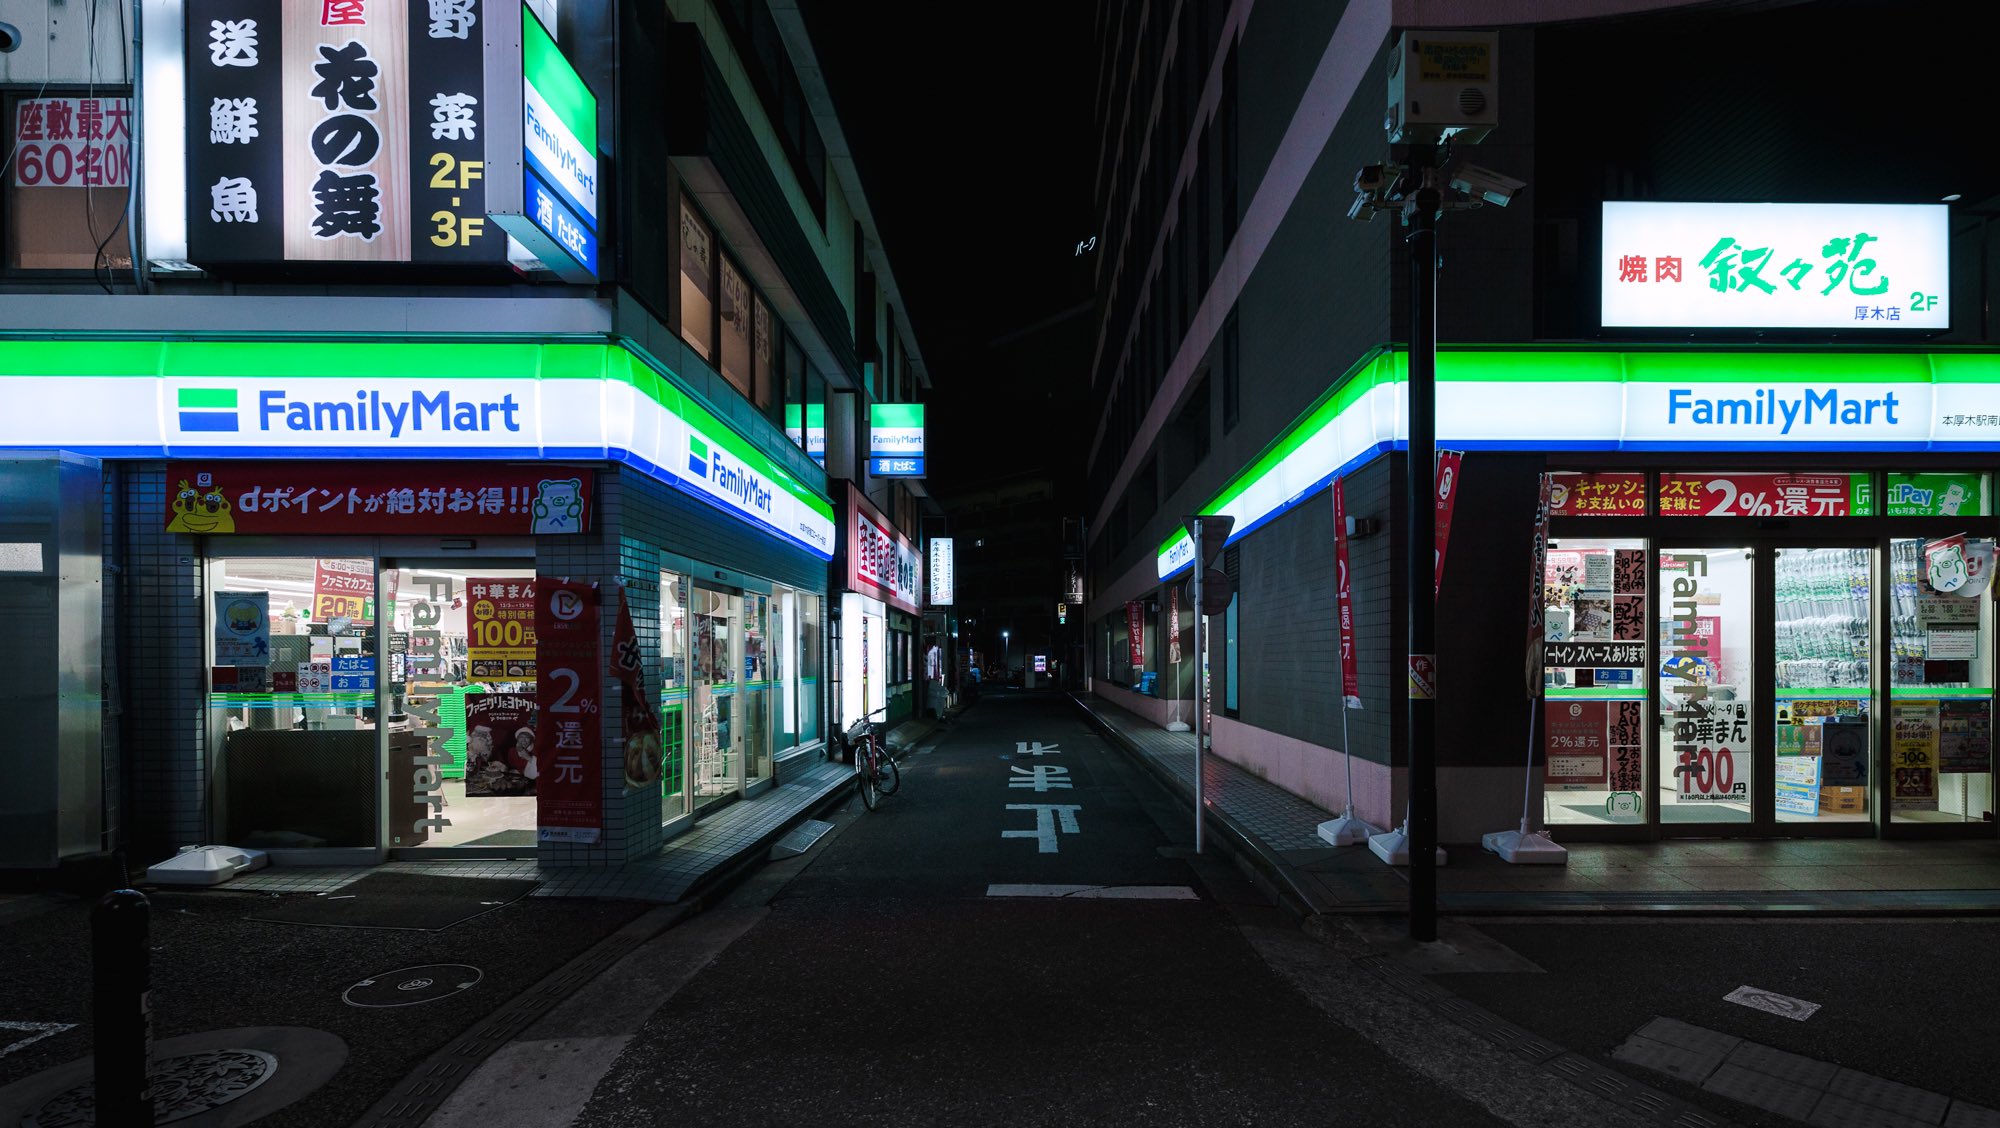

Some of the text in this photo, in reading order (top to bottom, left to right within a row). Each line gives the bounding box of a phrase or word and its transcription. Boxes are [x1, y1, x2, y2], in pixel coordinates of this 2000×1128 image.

[18, 98, 131, 142] 座敷最大
[310, 40, 382, 242] 花の舞
[524, 103, 596, 197] FamilyMart
[429, 152, 484, 190] 2F
[429, 210, 485, 248] 3F
[536, 188, 588, 263] 酒 たばこ
[1618, 232, 1938, 324] 焼肉 叙々苑 2F
[1853, 306, 1901, 322] 厚木店
[258, 390, 520, 438] FamilyMart
[1668, 388, 1900, 435] FamilyMart
[872, 434, 923, 446] FamilyMart
[711, 453, 773, 515] FamilyMart
[878, 460, 917, 473] 酒 たばこ
[238, 485, 531, 516] dポイントが絶対お得!!
[1575, 497, 1702, 511] お支払いの客様に
[320, 574, 375, 592] ファミマカフェ
[472, 584, 536, 600] 中華まん
[1964, 578, 1986, 587] OINT
[472, 620, 538, 647] 100円
[338, 661, 370, 670] たばこ
[1664, 555, 1708, 778] FamilyMart
[402, 577, 454, 833] FamilyMart
[554, 720, 585, 785] 還元
[1551, 736, 1600, 748] 2%還元
